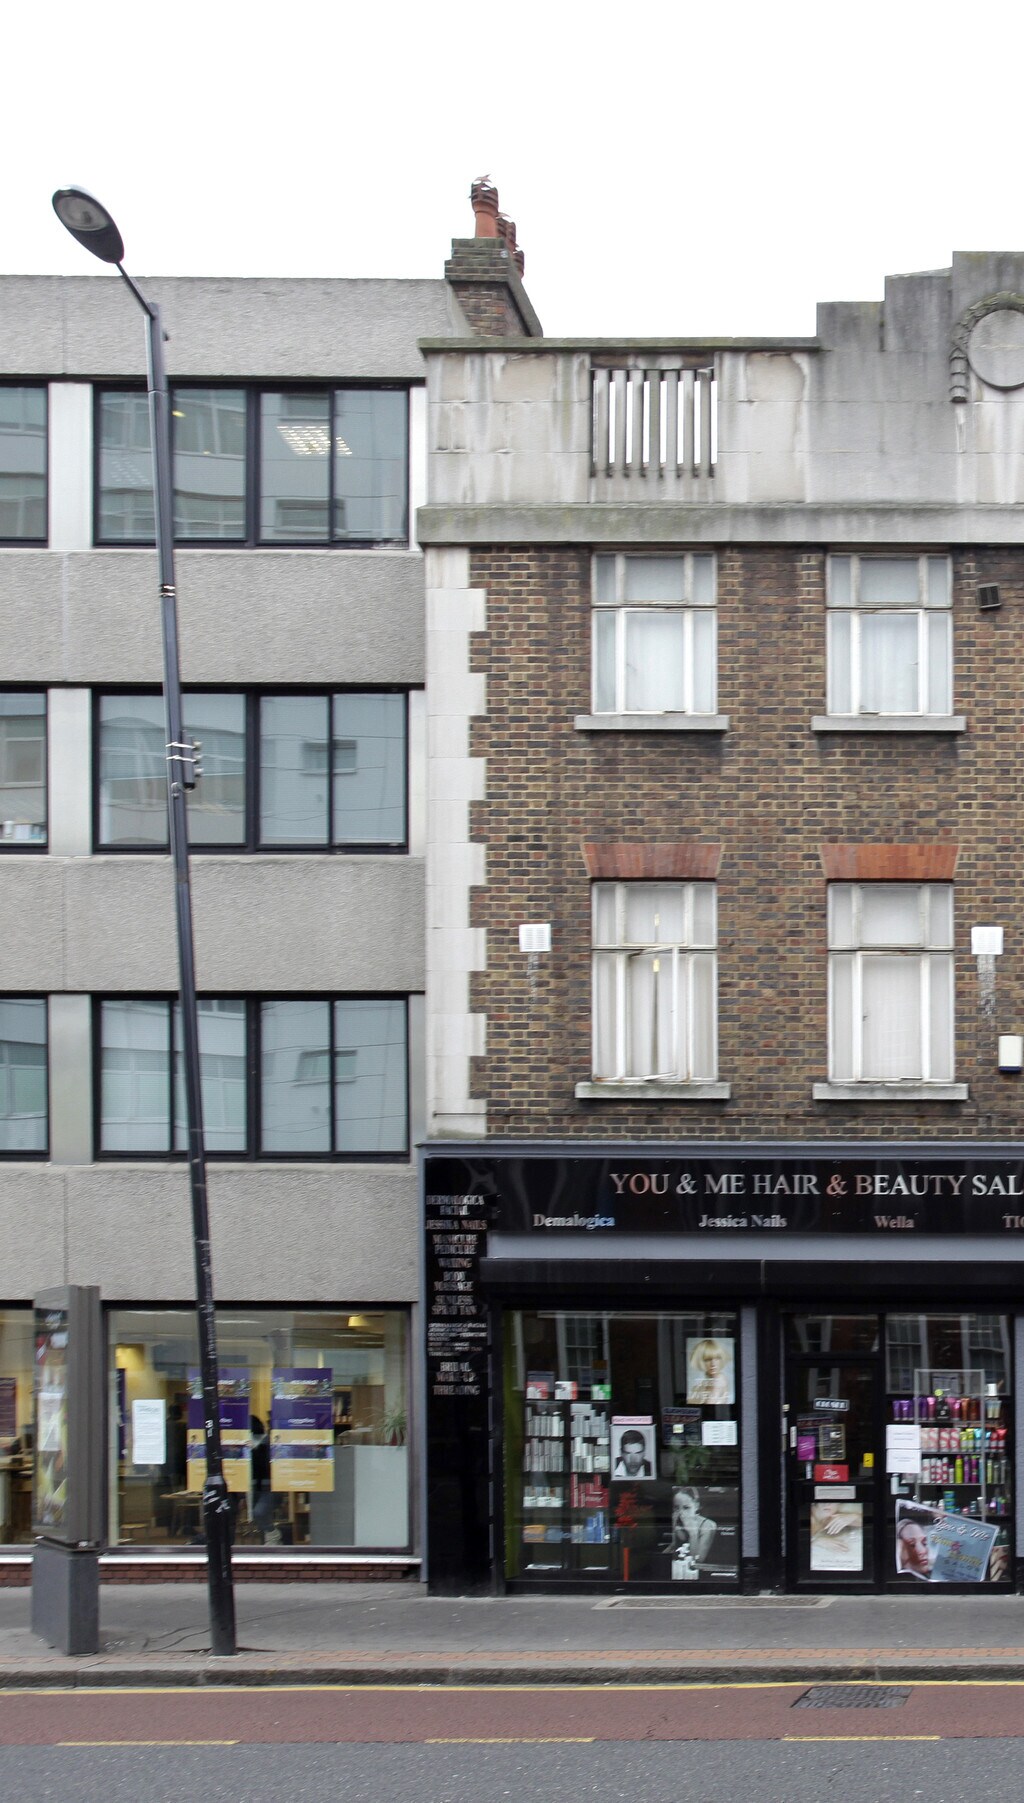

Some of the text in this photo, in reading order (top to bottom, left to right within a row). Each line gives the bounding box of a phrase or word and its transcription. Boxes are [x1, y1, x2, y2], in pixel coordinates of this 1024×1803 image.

[612, 1173, 670, 1195] YOU
[676, 1173, 697, 1195] &
[705, 1174, 746, 1195] ME
[752, 1174, 820, 1195] HAIR
[826, 1174, 847, 1196] &
[856, 1174, 965, 1196] BEAUTY
[533, 1213, 615, 1229] Demalogica
[699, 1214, 787, 1228] Jessica Nails
[874, 1215, 915, 1229] Wella
